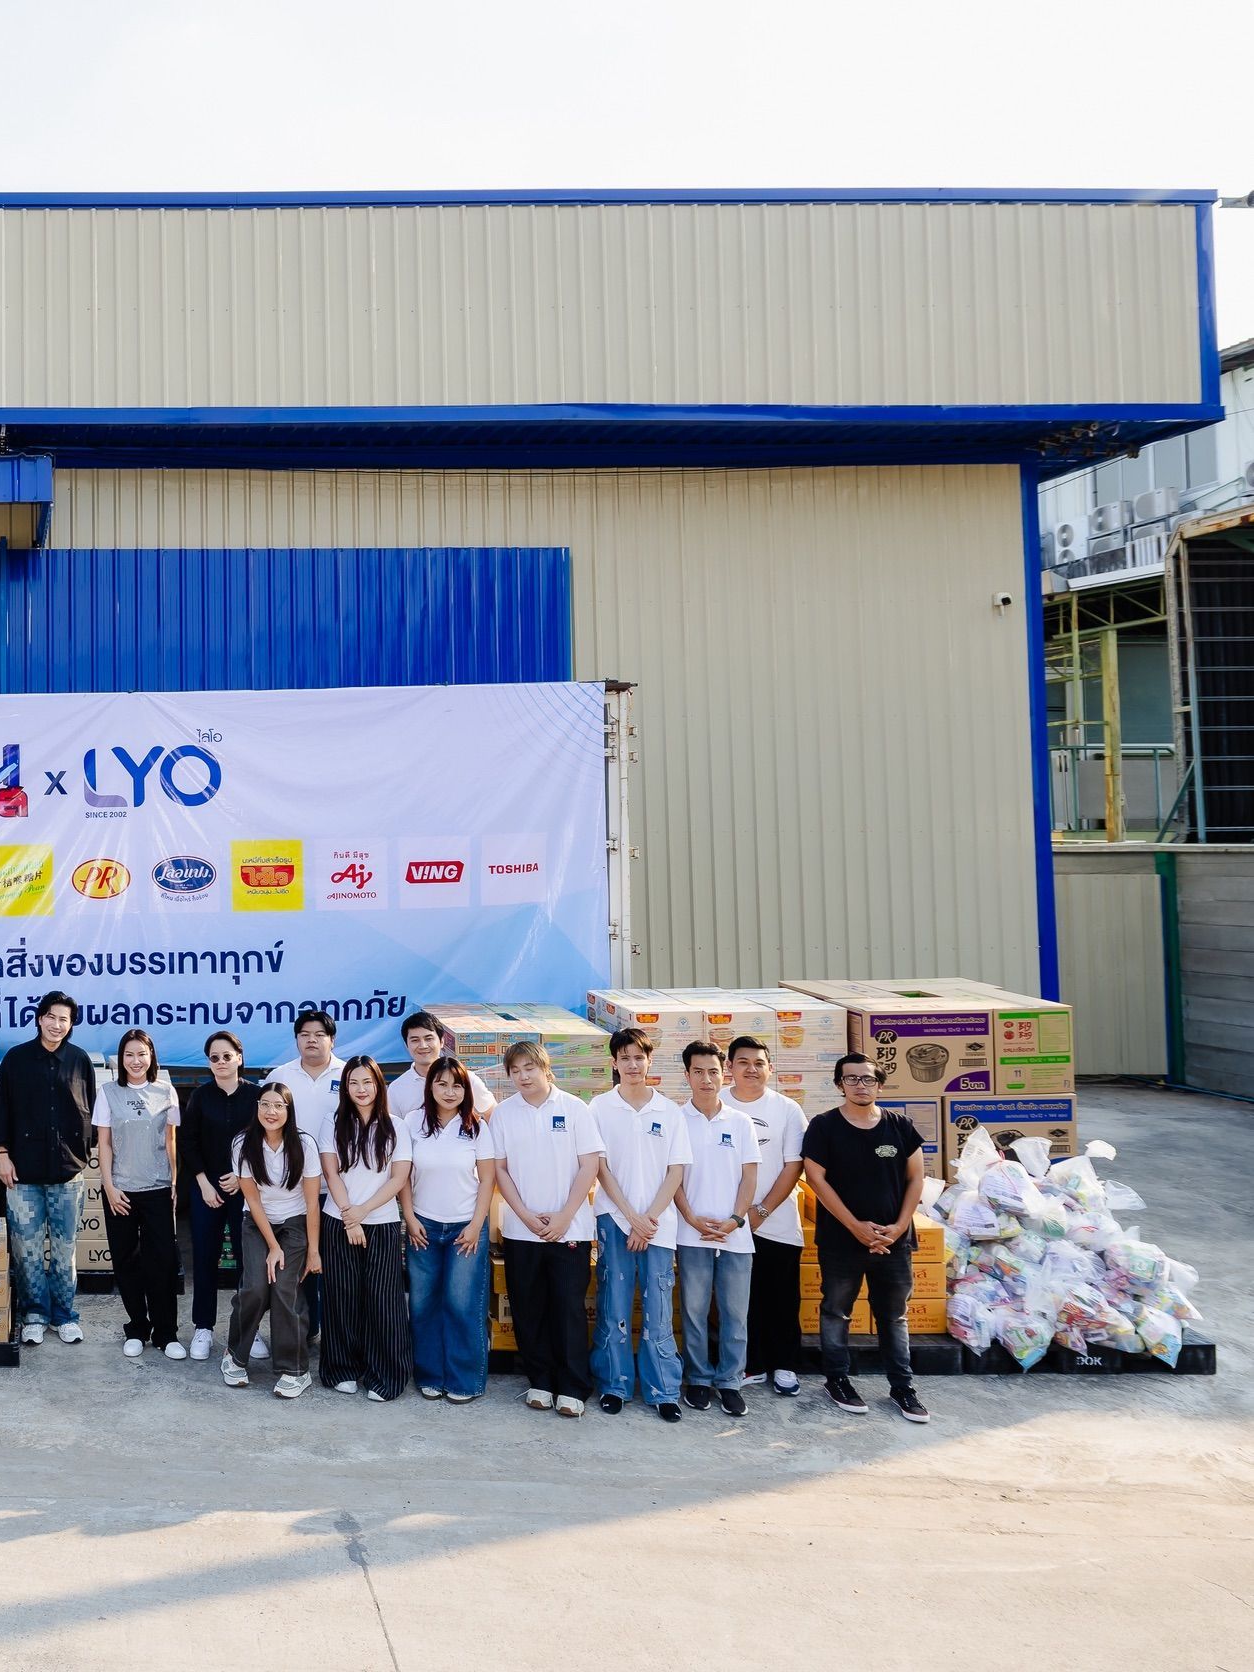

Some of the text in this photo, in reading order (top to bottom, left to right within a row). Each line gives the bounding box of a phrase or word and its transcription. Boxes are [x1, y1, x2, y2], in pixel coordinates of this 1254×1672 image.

[196, 729, 222, 743] ไลโอ
[83, 745, 222, 808] LYO
[85, 810, 127, 819] SINCE 2002
[488, 862, 540, 875] TOSHIBA
[79, 866, 118, 895] PR
[326, 892, 377, 900] AJINOMOTO
[878, 1031, 893, 1044] PR
[876, 1046, 897, 1062] Big
[879, 1062, 897, 1075] ag
[958, 1118, 975, 1130] PR
[88, 1188, 102, 1200] LY
[80, 1218, 100, 1231] YO
